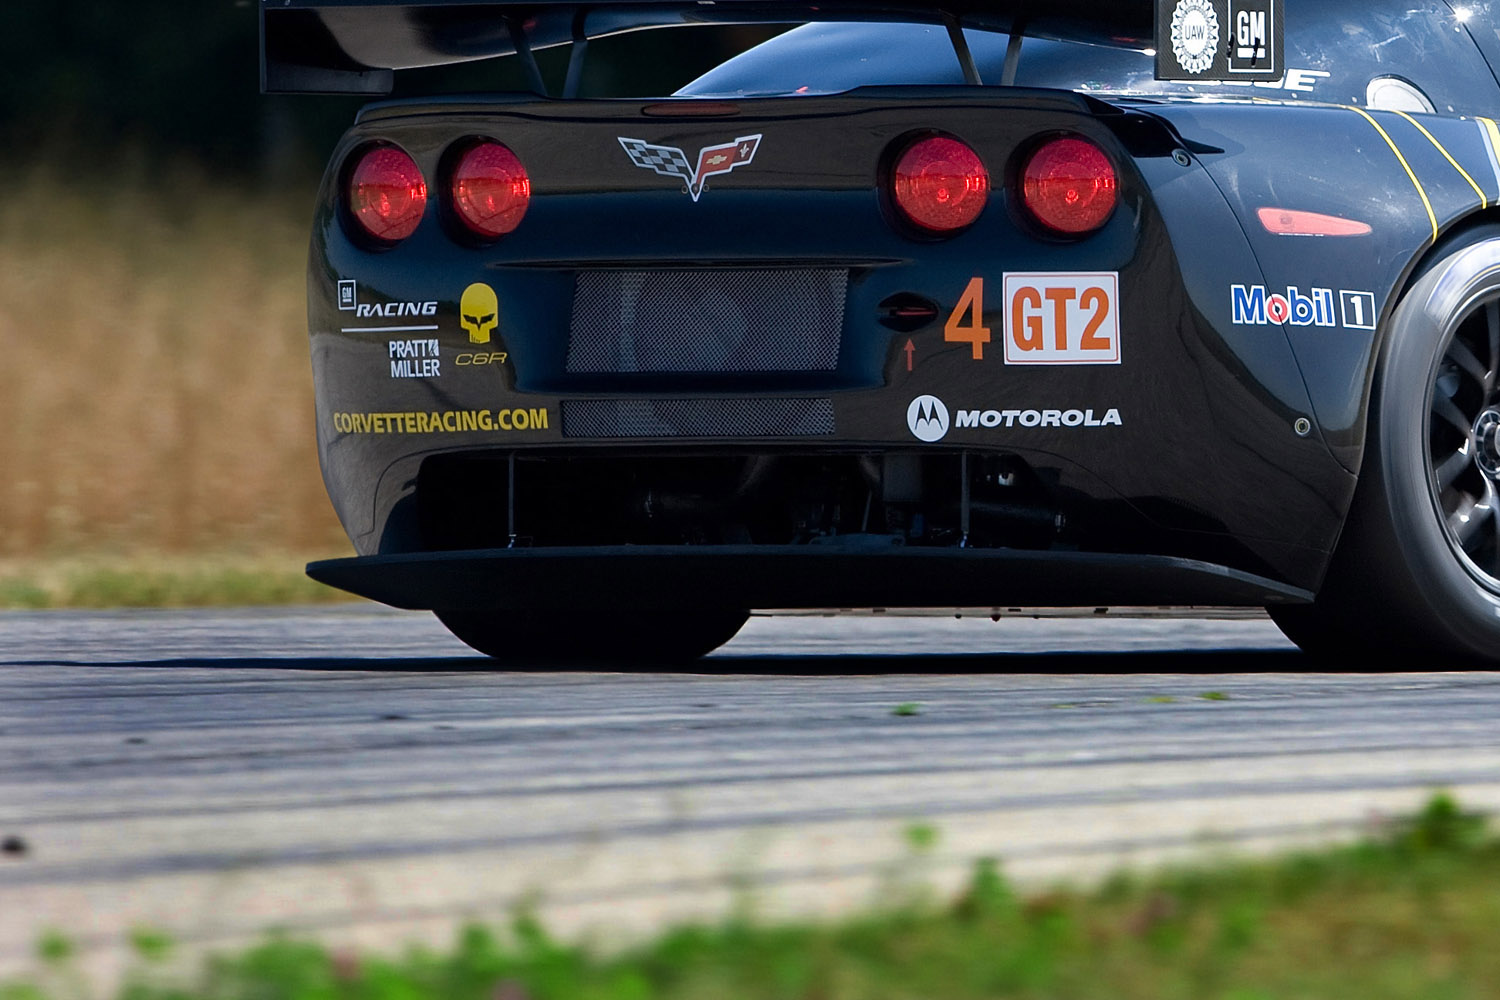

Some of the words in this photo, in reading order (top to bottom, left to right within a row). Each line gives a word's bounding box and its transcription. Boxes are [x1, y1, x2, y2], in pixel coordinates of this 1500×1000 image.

[1184, 25, 1206, 40] UAW
[1236, 10, 1266, 46] GM
[356, 301, 438, 317] RACING
[1230, 284, 1336, 327] Mobil
[1350, 295, 1364, 326] 1
[943, 277, 992, 360] 4
[1011, 286, 1112, 351] GT2
[388, 340, 428, 358] PRATT
[390, 359, 441, 378] MILLER
[333, 408, 549, 434] CORVETTERACING.COM
[955, 408, 1123, 428] MOTOROLA
